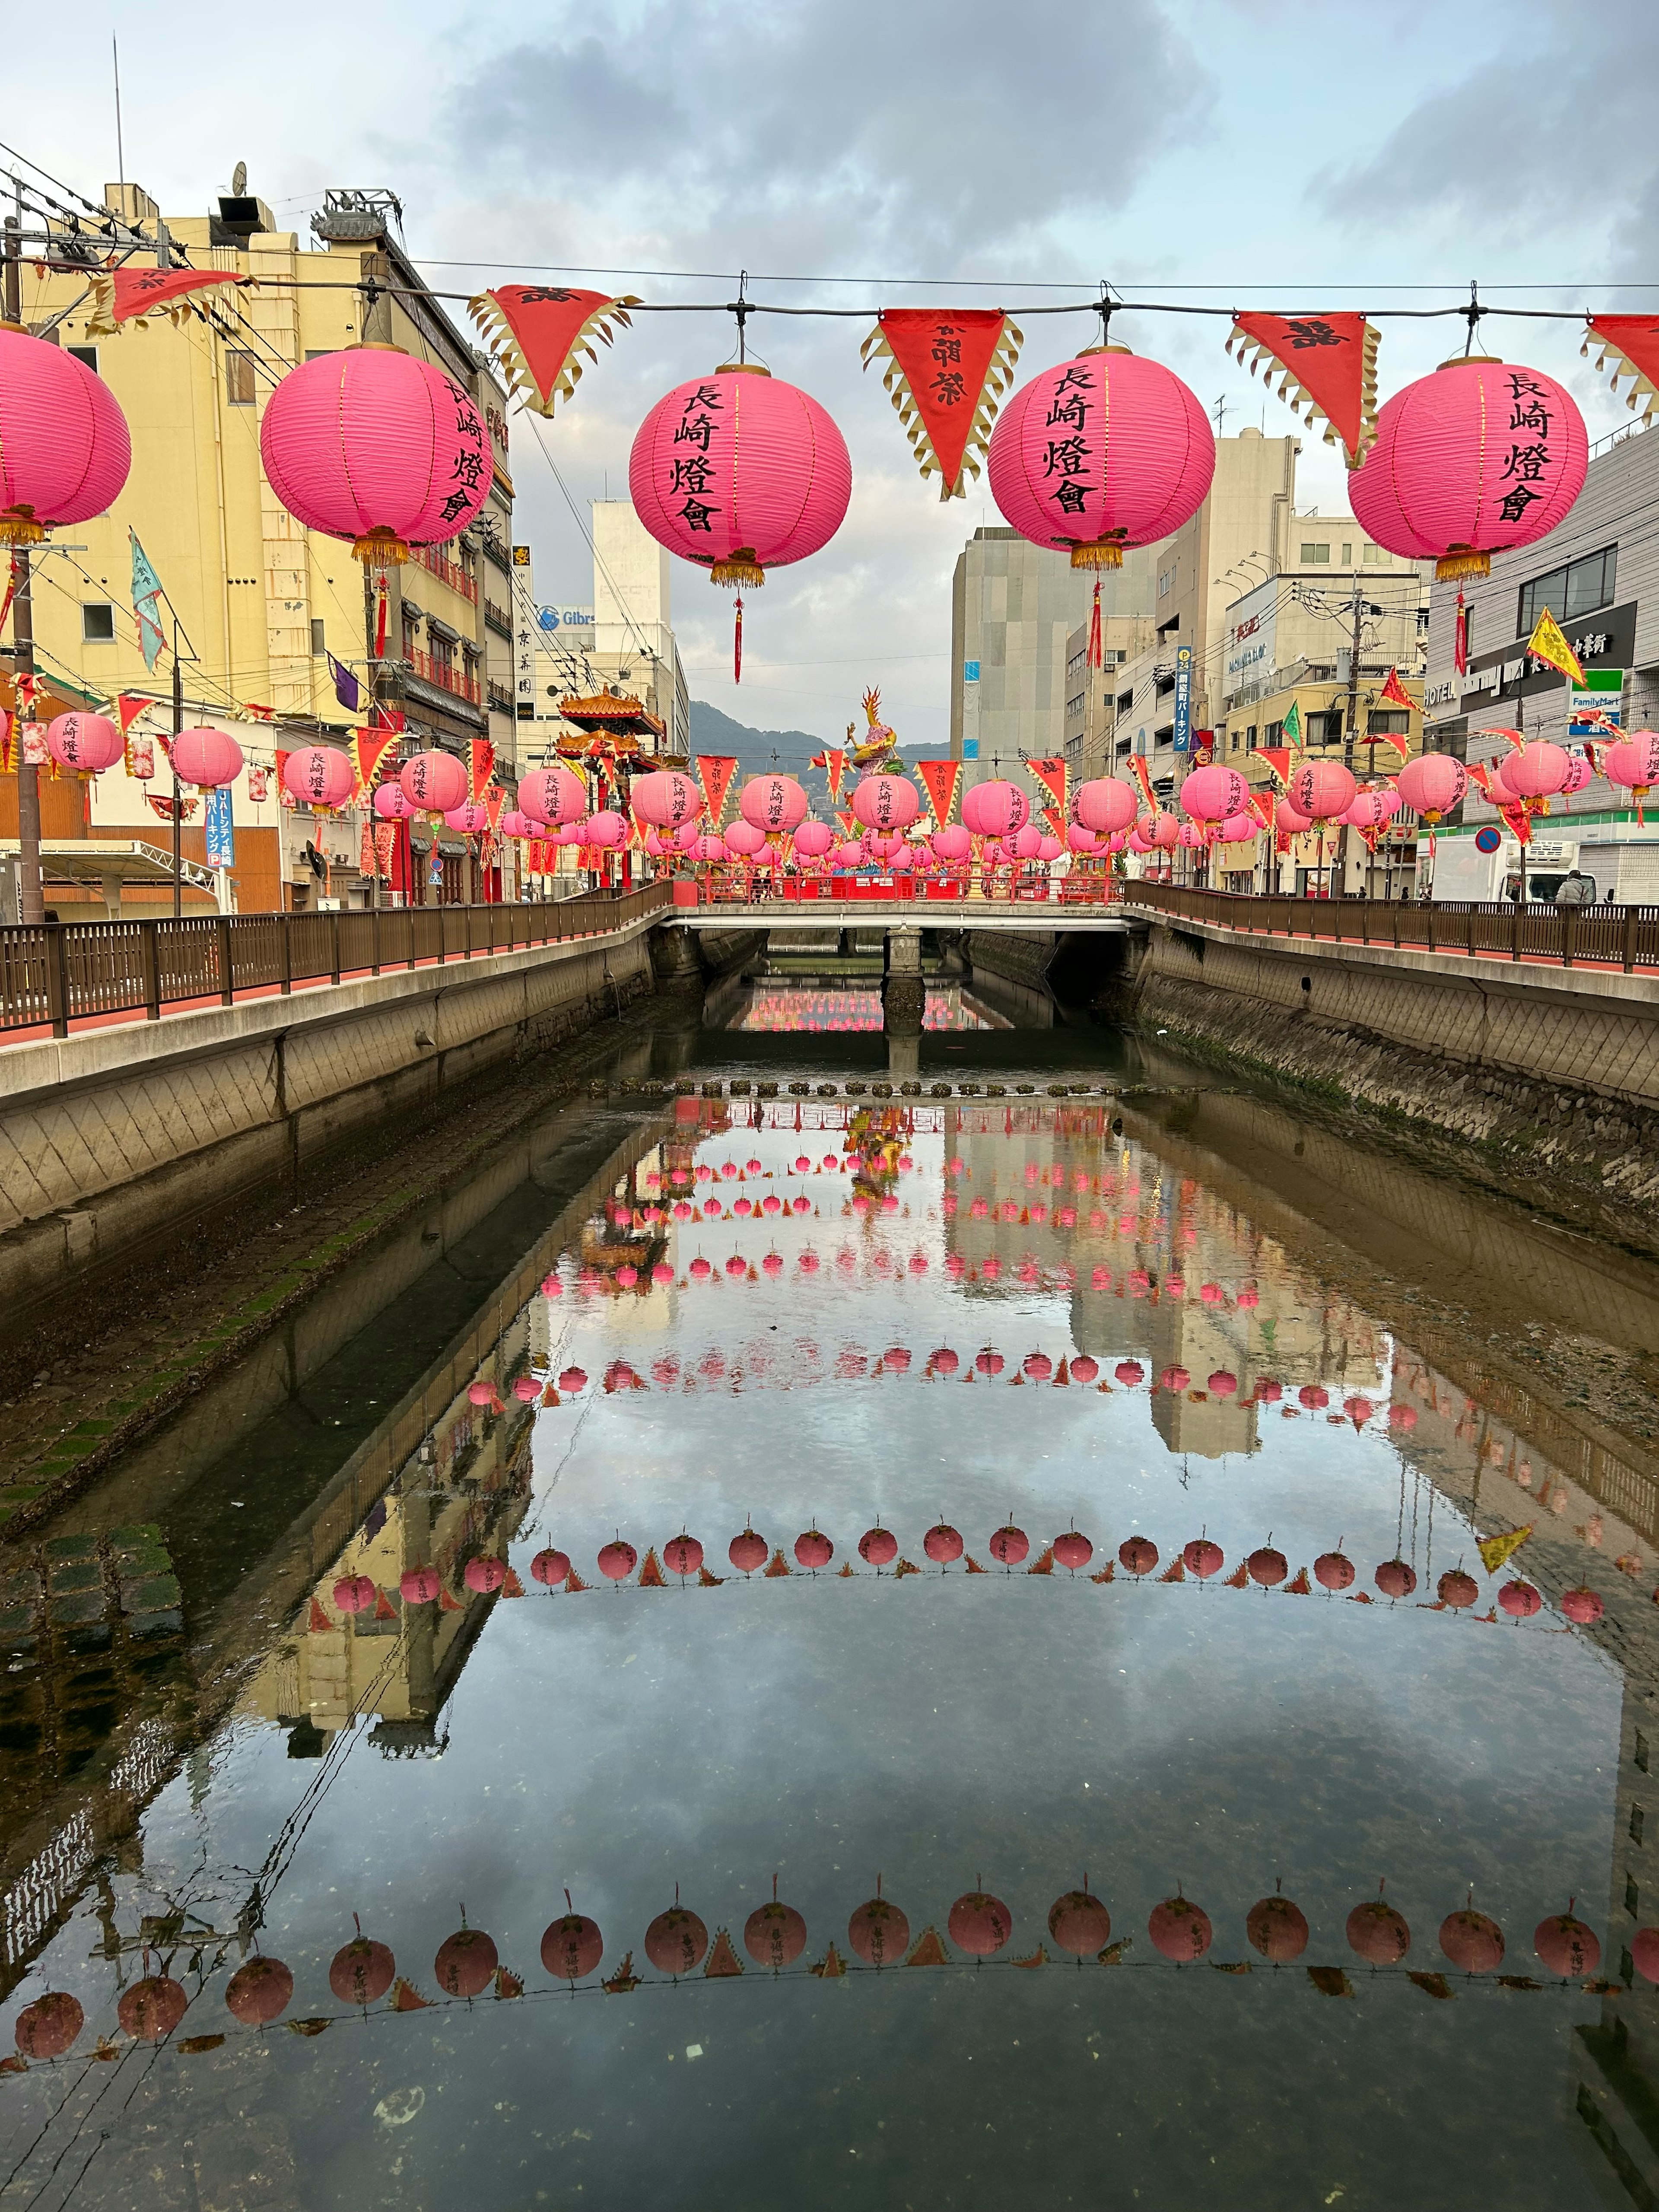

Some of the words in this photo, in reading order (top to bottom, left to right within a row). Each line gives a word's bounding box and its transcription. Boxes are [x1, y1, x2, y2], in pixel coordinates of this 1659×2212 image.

[440, 374, 484, 523] 長崎燈會
[670, 384, 724, 532] 長崎燈會
[1043, 365, 1099, 514] 長崎燈會
[1493, 373, 1554, 523] 長崎燈會
[1177, 674, 1188, 746] 銅座町パーキング
[1423, 681, 1457, 707] HOTEL
[1573, 697, 1619, 706] FamilyMart
[62, 717, 80, 763] 長崎燈會
[308, 753, 327, 798] 長崎燈會
[413, 759, 429, 799] 長崎燈會
[544, 774, 561, 819] 長崎燈會
[1224, 773, 1243, 815] 長崎燈會
[1300, 769, 1316, 810] 長崎燈會
[671, 777, 687, 821] 長崎燈會
[767, 781, 785, 826] 長崎燈會
[877, 781, 893, 824] 長崎燈會
[1007, 788, 1023, 831] 長崎燈會
